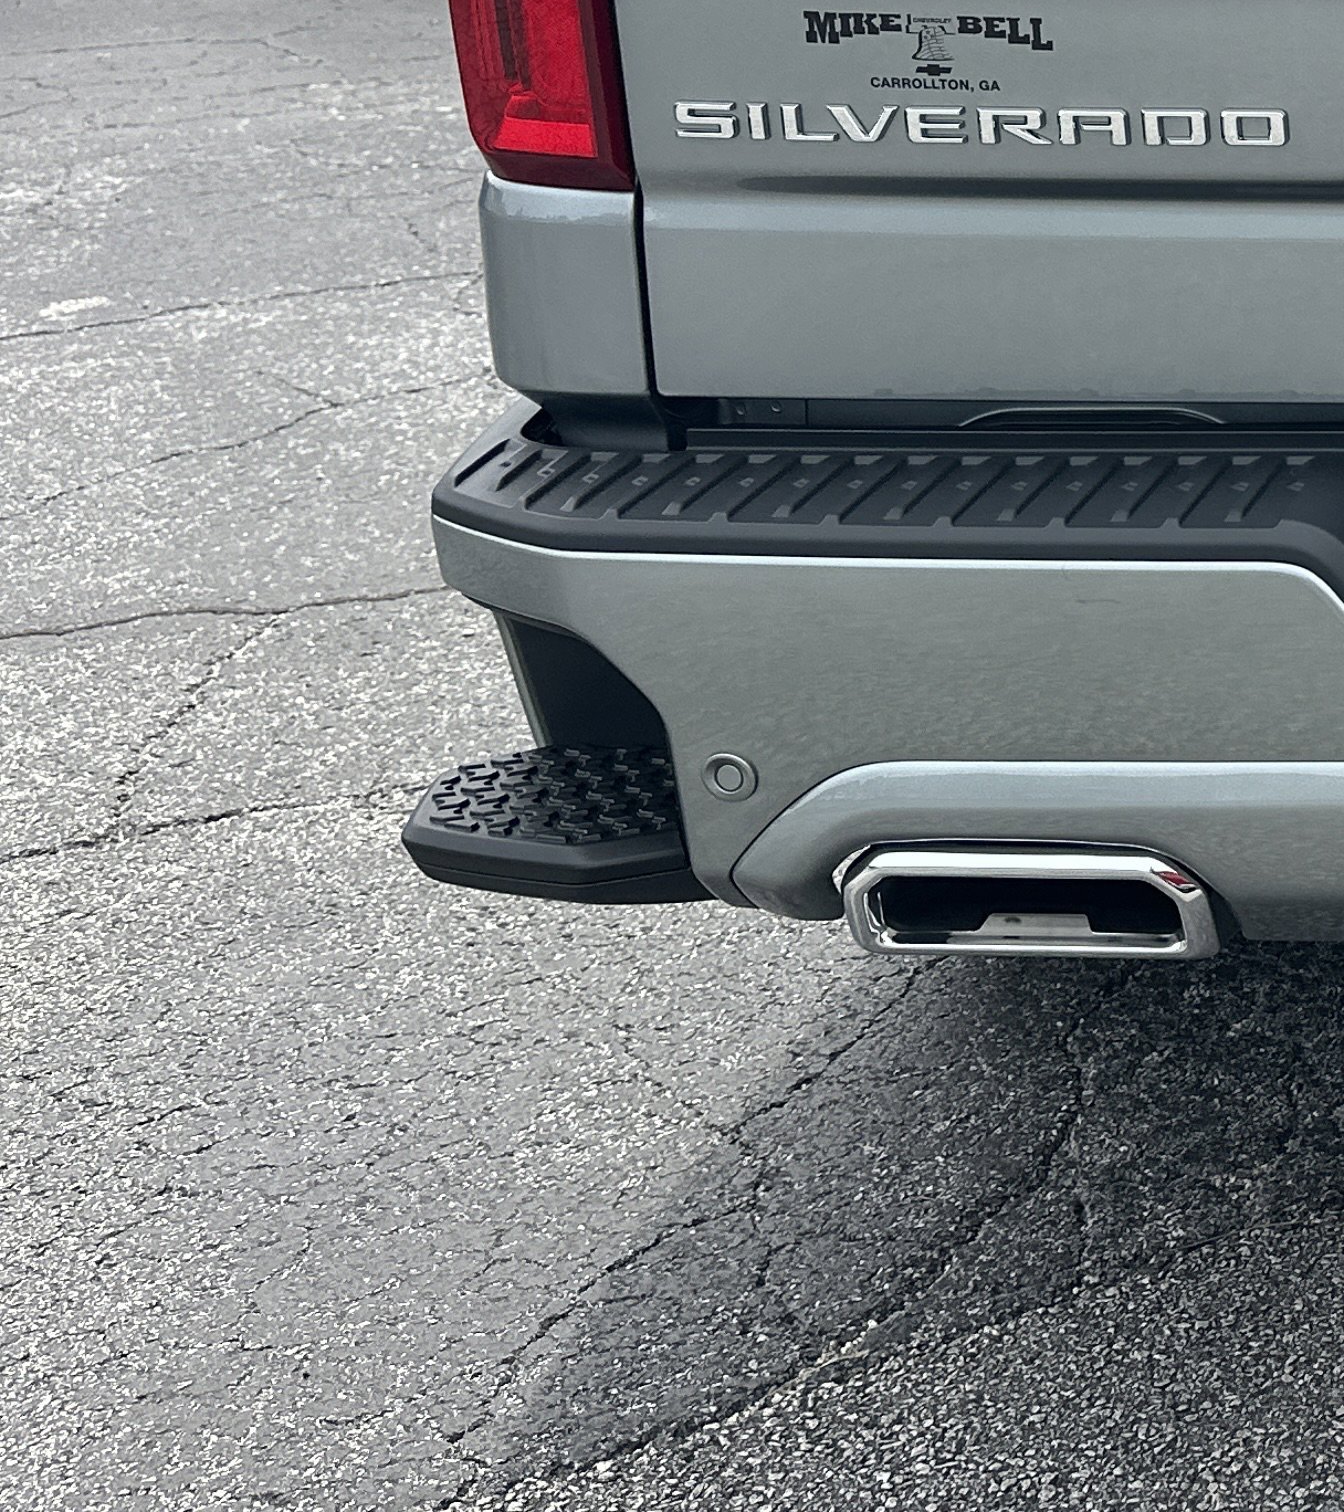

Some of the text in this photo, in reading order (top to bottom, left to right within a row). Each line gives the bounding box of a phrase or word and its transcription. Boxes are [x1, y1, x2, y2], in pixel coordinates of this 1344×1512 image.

[803, 10, 1054, 51] MIKE BELL
[870, 76, 1001, 93] CARROLLTON, GA
[673, 101, 1291, 147] SILVERADO
